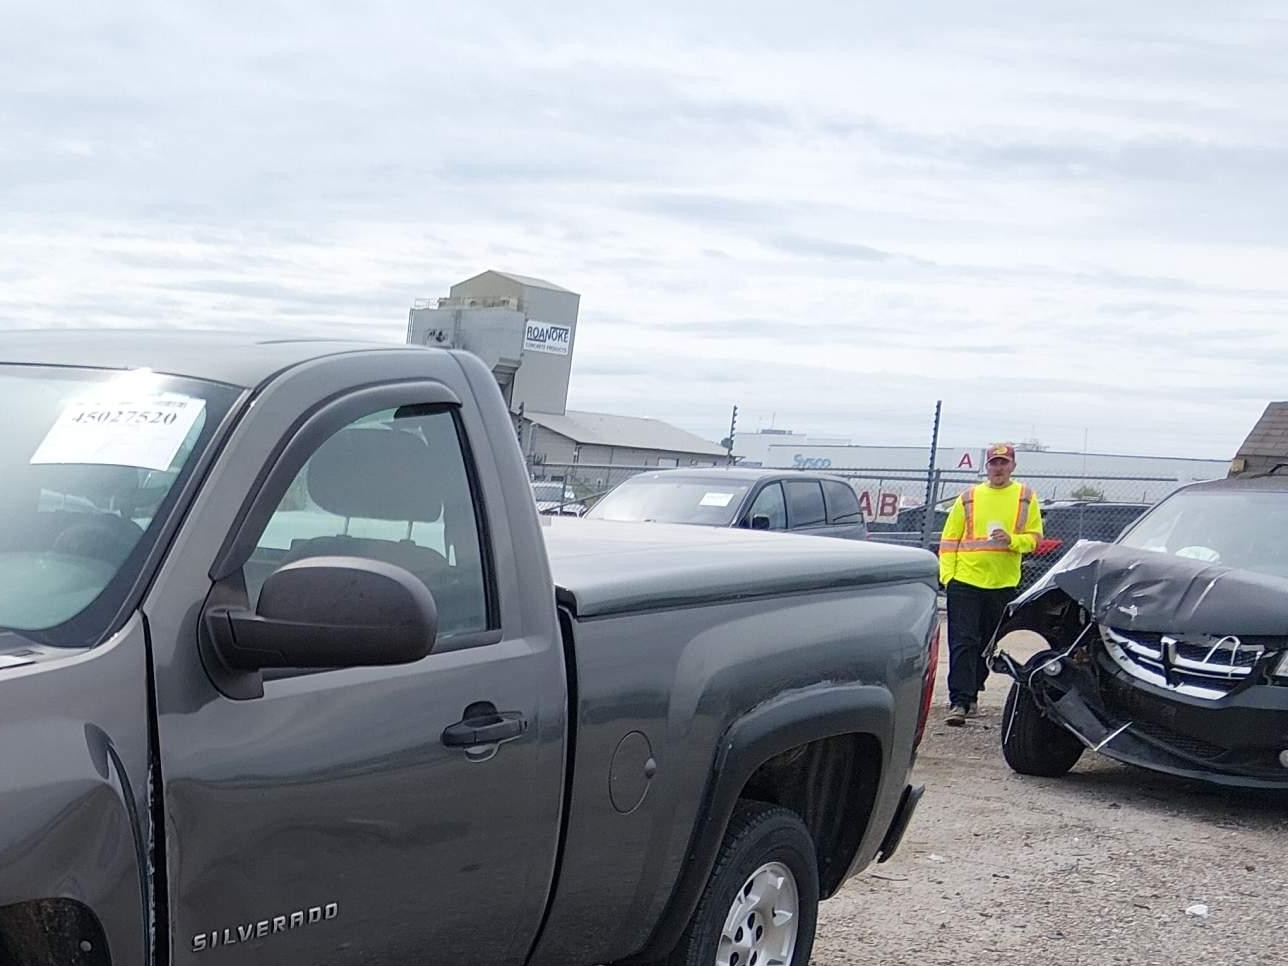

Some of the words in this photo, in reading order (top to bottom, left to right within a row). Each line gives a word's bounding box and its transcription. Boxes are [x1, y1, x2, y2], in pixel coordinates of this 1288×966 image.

[527, 326, 569, 343] ROANOKE
[71, 410, 178, 425] 45027520
[957, 453, 972, 468] A
[879, 493, 898, 517] B
[192, 902, 339, 953] SILVERADO
